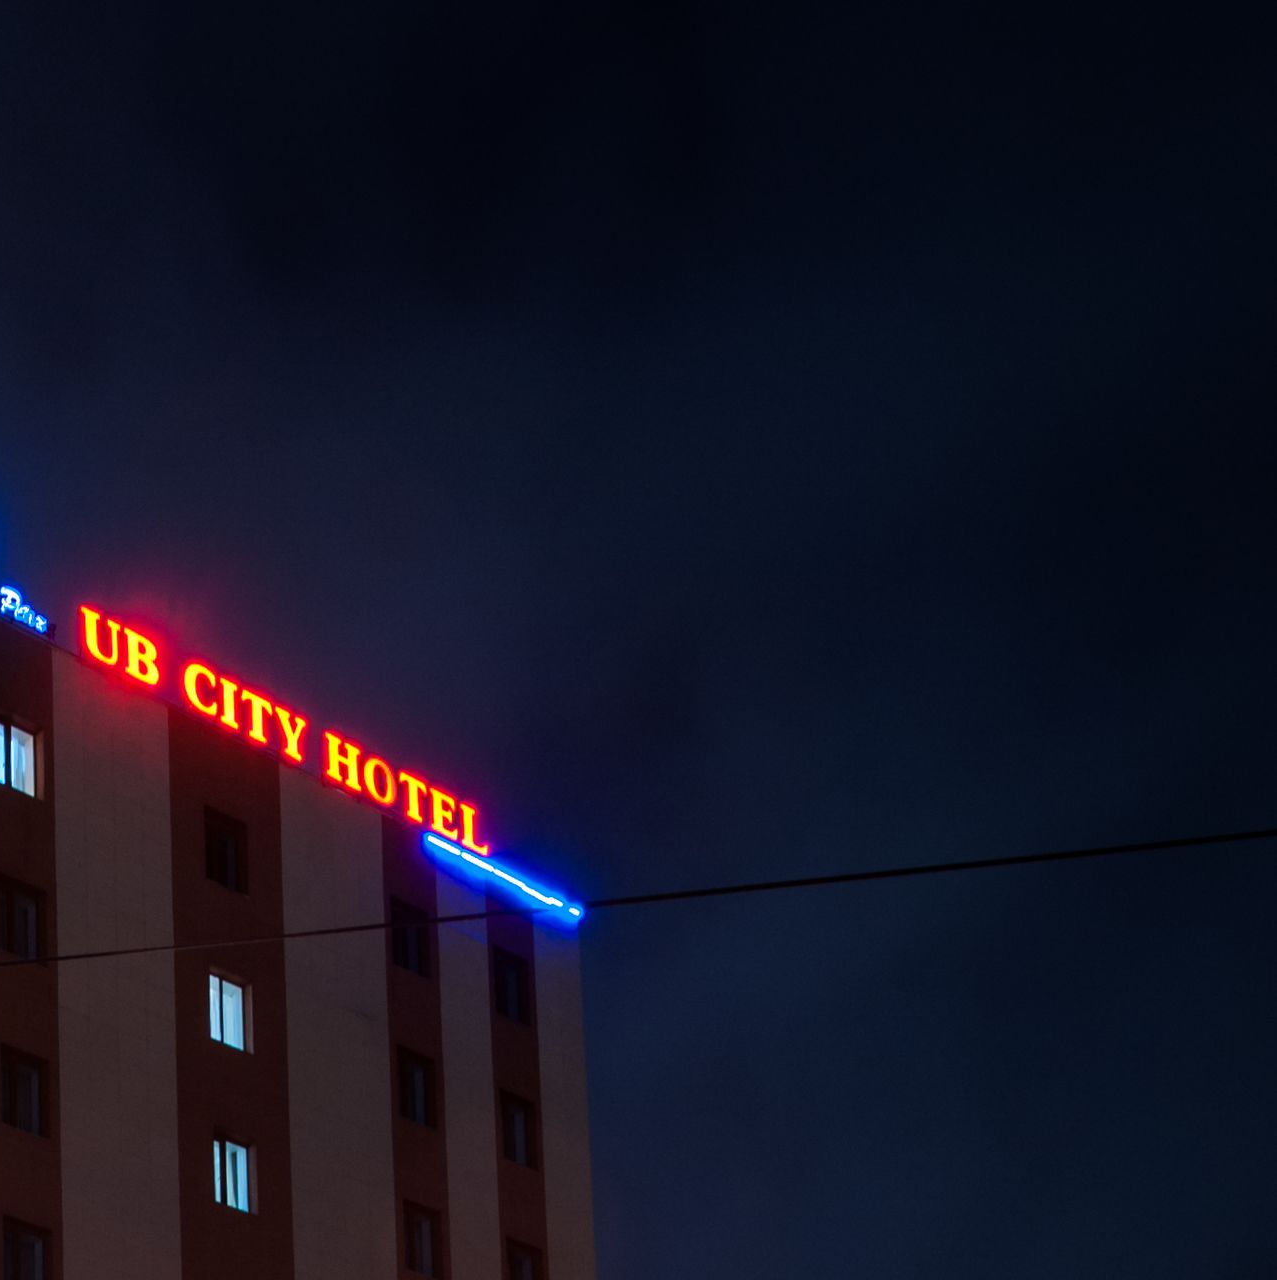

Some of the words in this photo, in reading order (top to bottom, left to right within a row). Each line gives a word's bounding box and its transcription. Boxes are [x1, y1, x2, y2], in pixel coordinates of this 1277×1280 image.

[79, 605, 162, 687] UB
[182, 662, 307, 765] CITY
[324, 730, 489, 856] HOTEL
